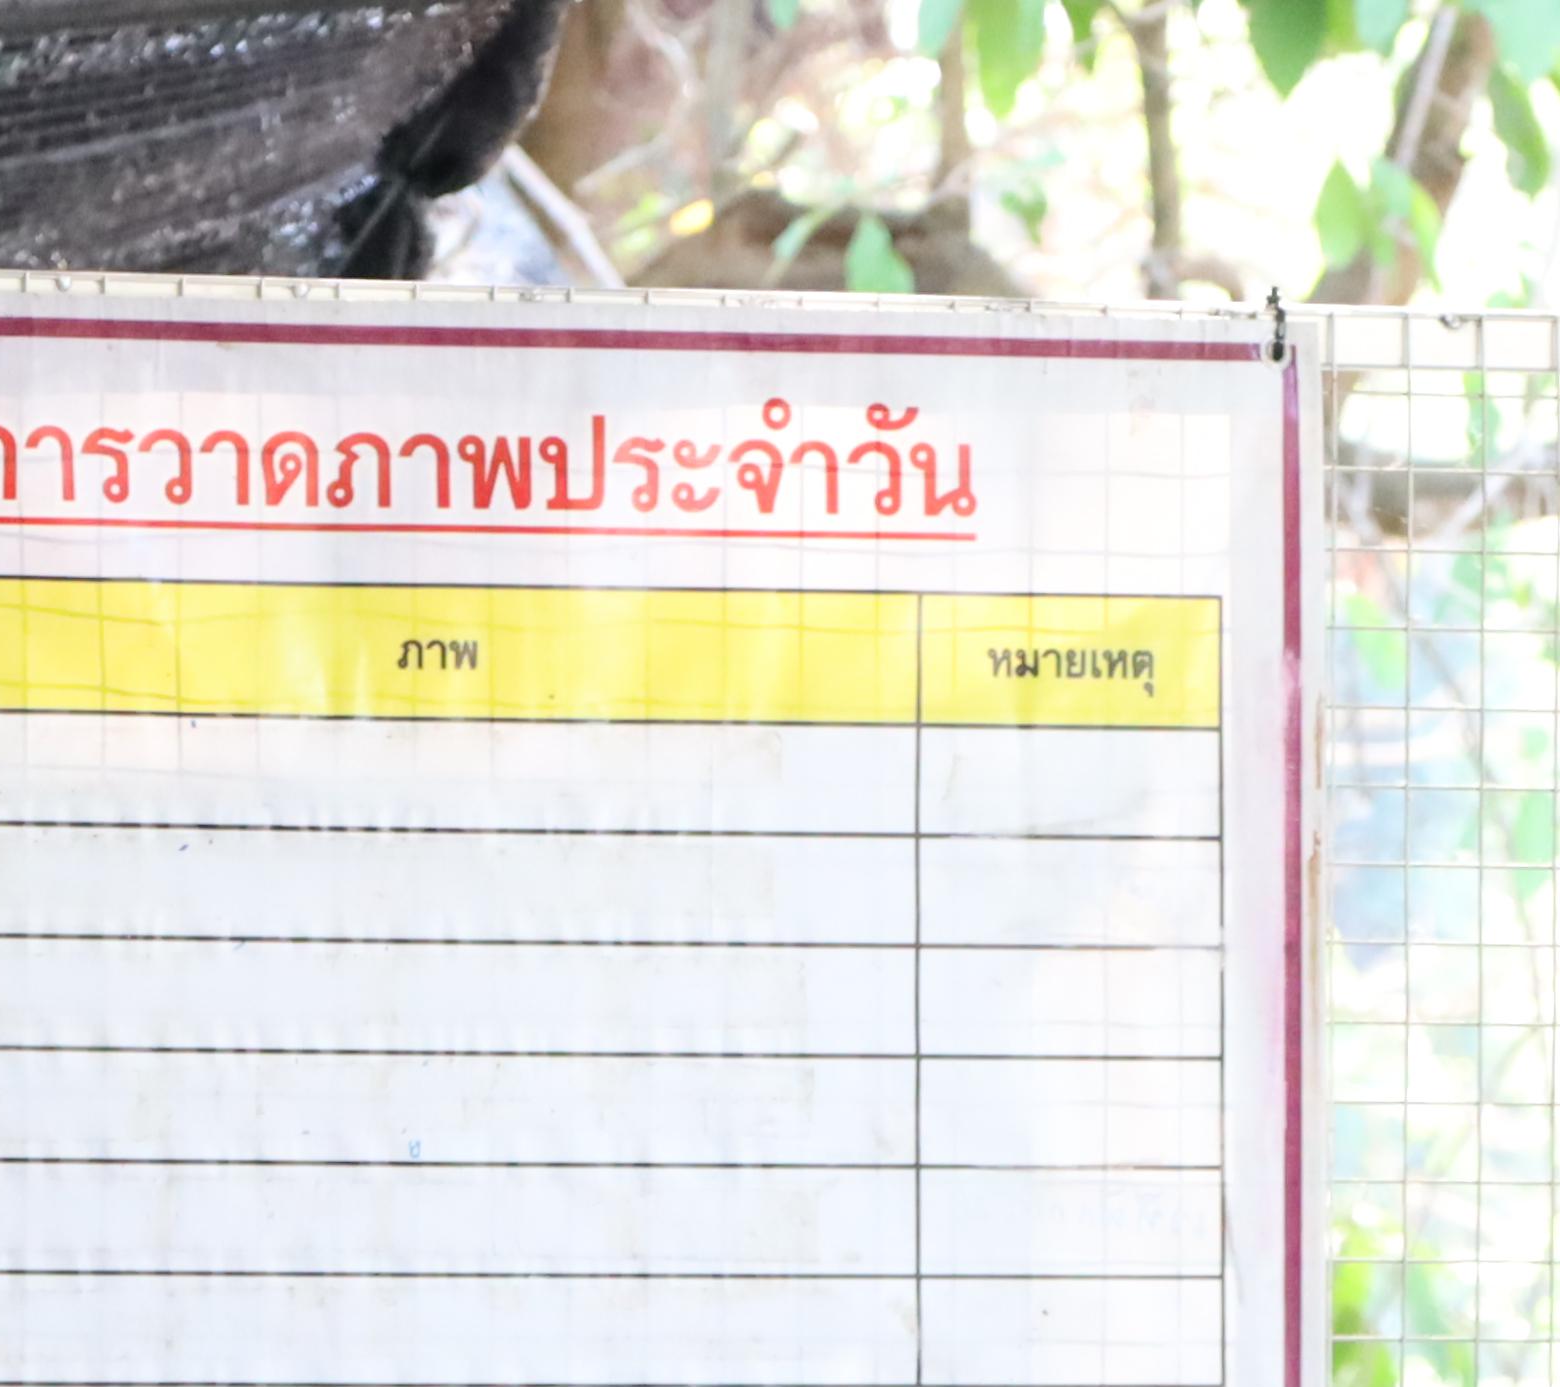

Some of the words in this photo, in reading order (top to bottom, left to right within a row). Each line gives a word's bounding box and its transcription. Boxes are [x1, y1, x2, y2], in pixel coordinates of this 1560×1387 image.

[397, 636, 479, 672] ภาพ
[988, 645, 1156, 698] หมายเหตุ
